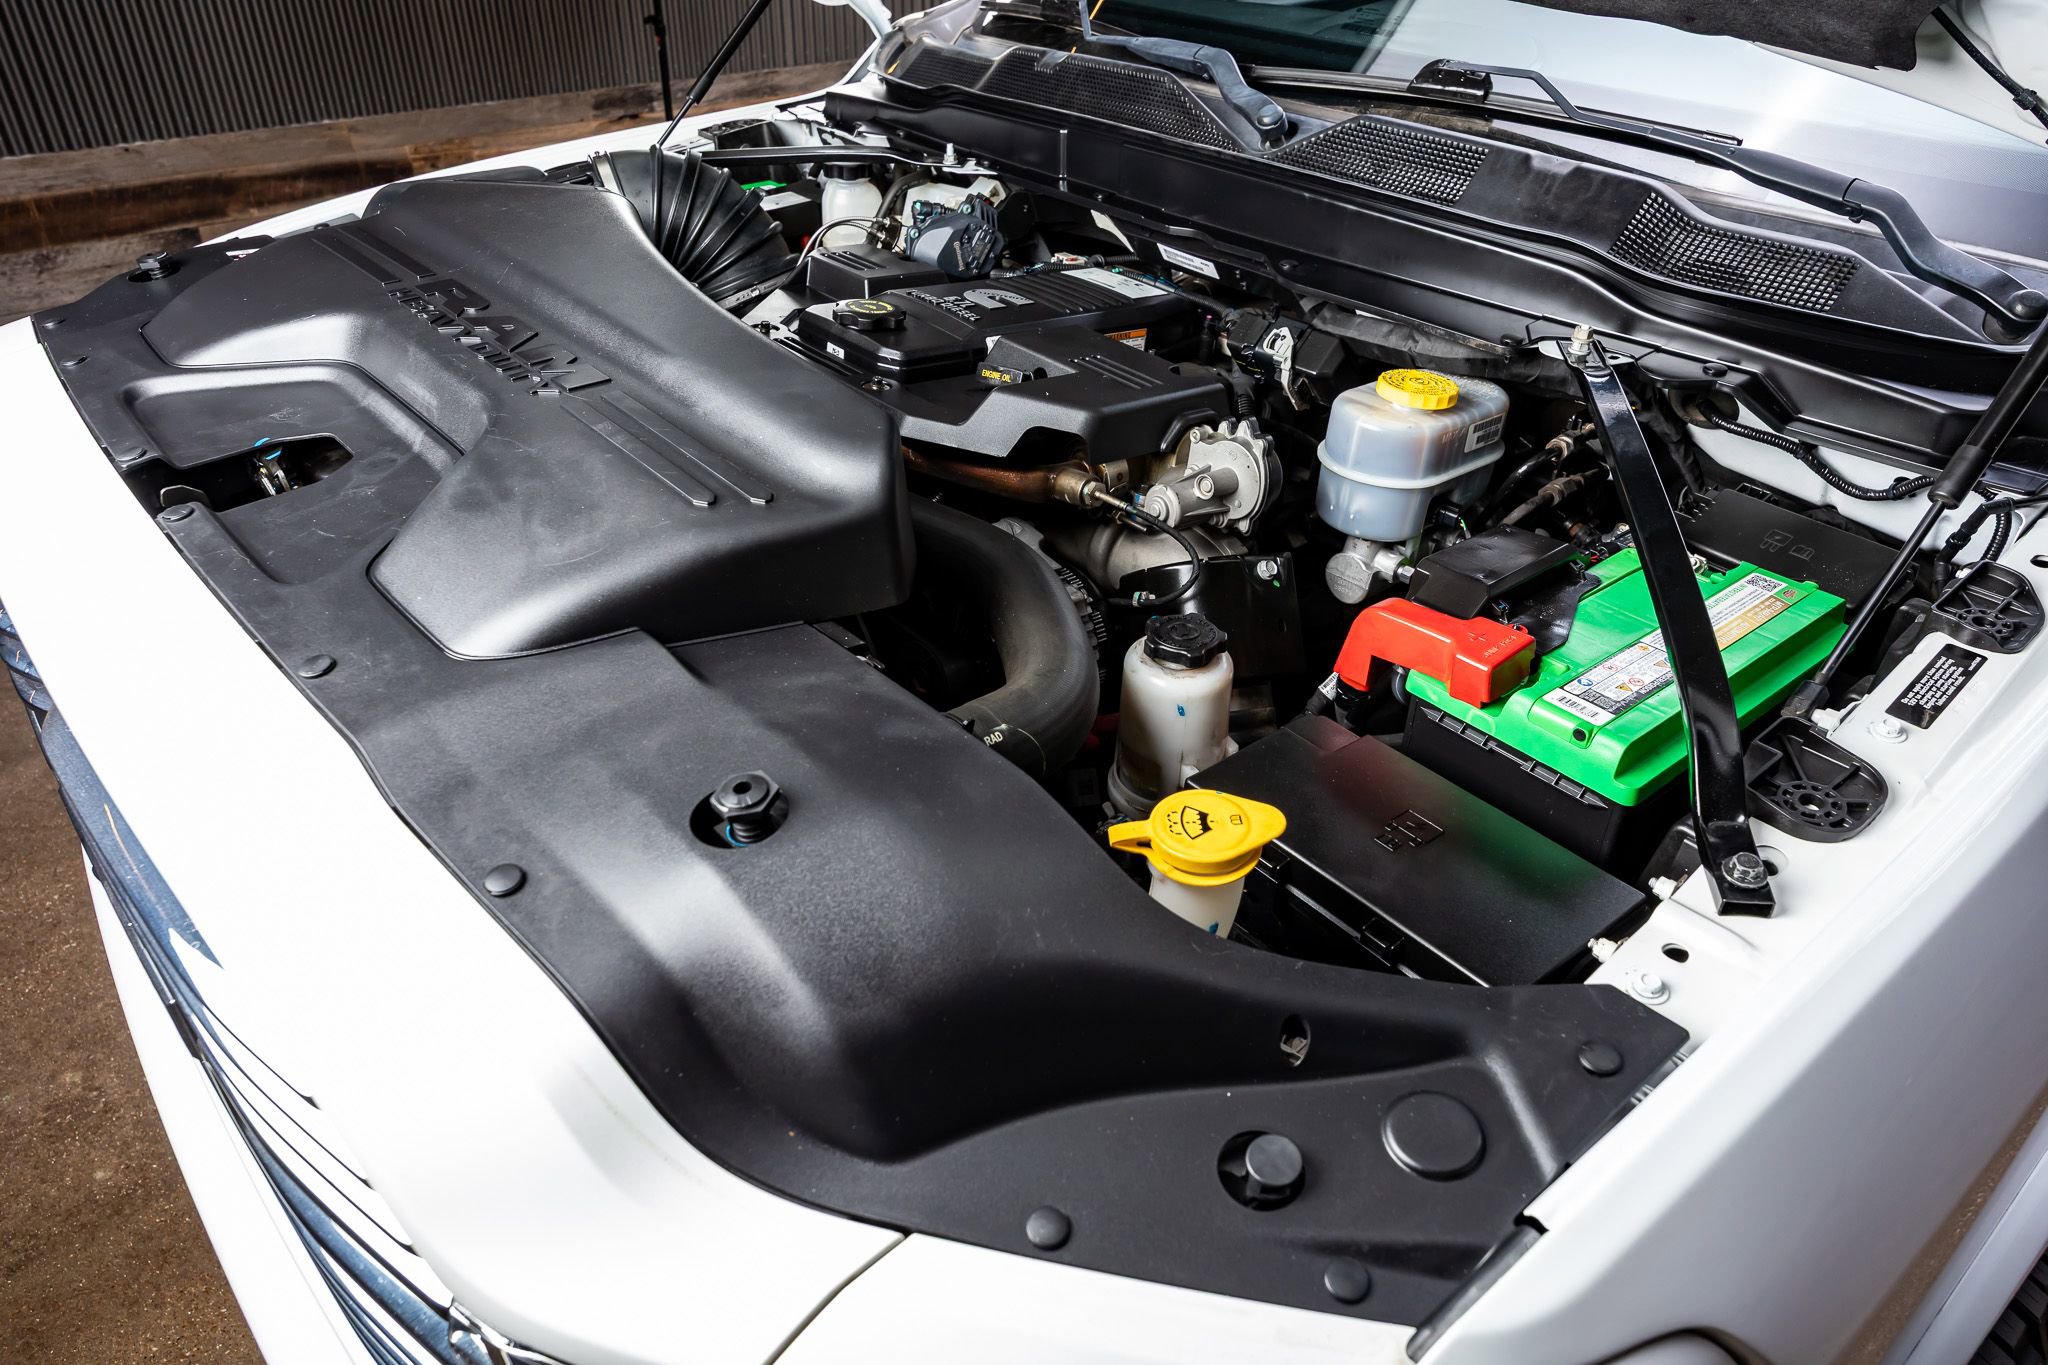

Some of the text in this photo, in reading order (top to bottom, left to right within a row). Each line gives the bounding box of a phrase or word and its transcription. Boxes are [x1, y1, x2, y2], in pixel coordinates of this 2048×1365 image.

[940, 302, 981, 321] DIESEL
[413, 278, 613, 392] RAM
[981, 369, 1012, 383] ENGINE OIL
[984, 731, 1003, 746] RAD
